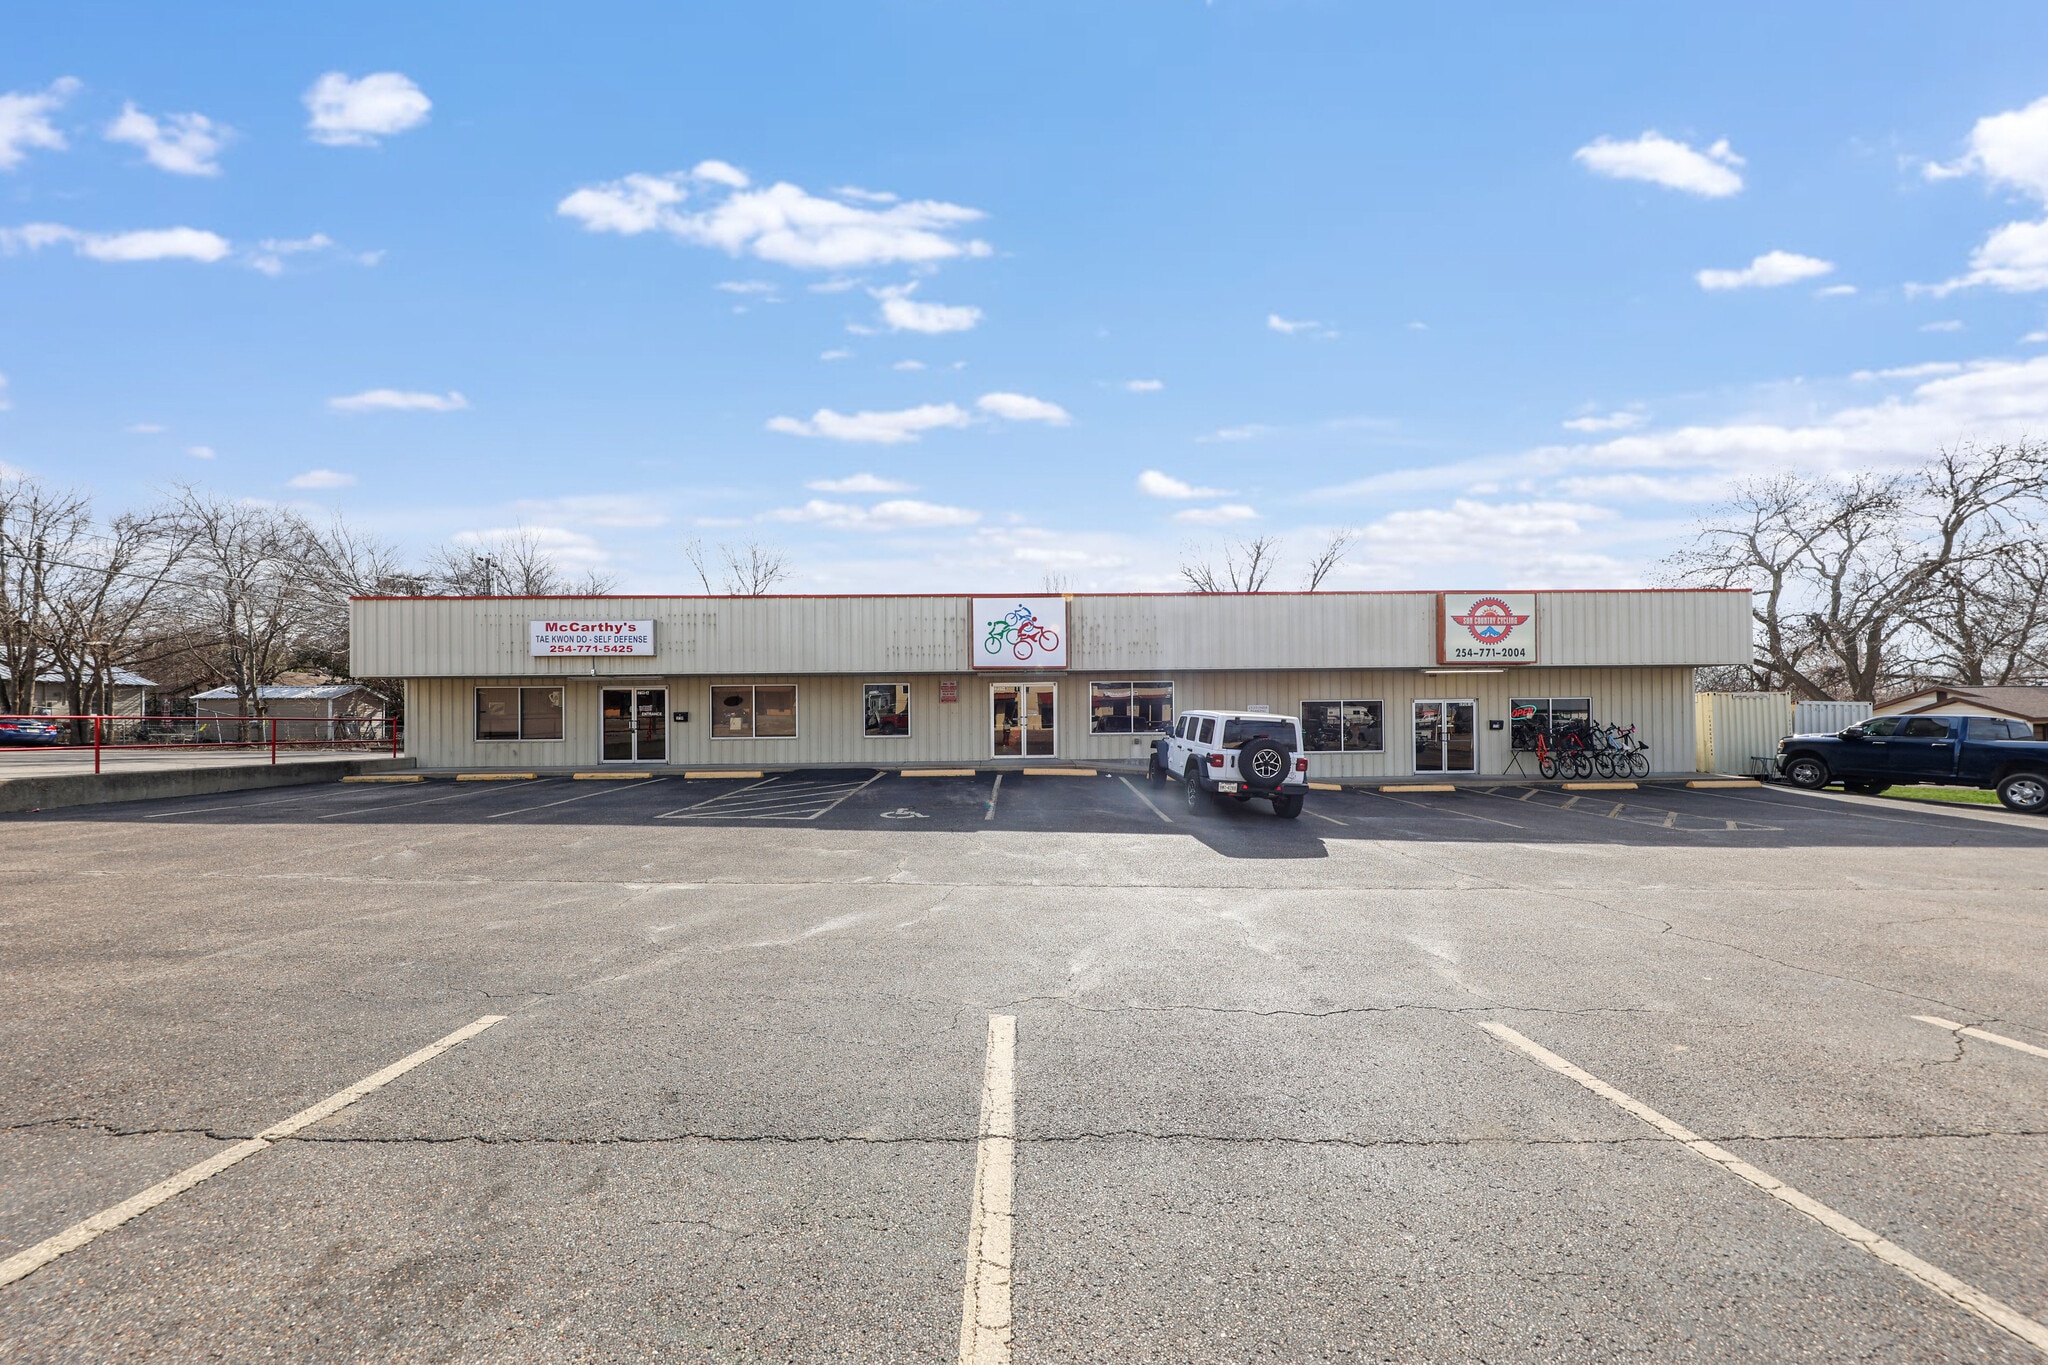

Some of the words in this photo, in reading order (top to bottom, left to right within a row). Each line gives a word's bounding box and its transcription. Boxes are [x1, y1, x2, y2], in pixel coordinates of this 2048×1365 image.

[545, 622, 636, 634] McCarthy's
[536, 635, 550, 643] TAE
[552, 635, 574, 643] KWON
[576, 635, 588, 643] DO
[594, 635, 612, 643] SELF
[614, 635, 648, 643] DEFENSE
[1456, 648, 1526, 658] 254-771-2004
[1512, 708, 1534, 718] OPEN
